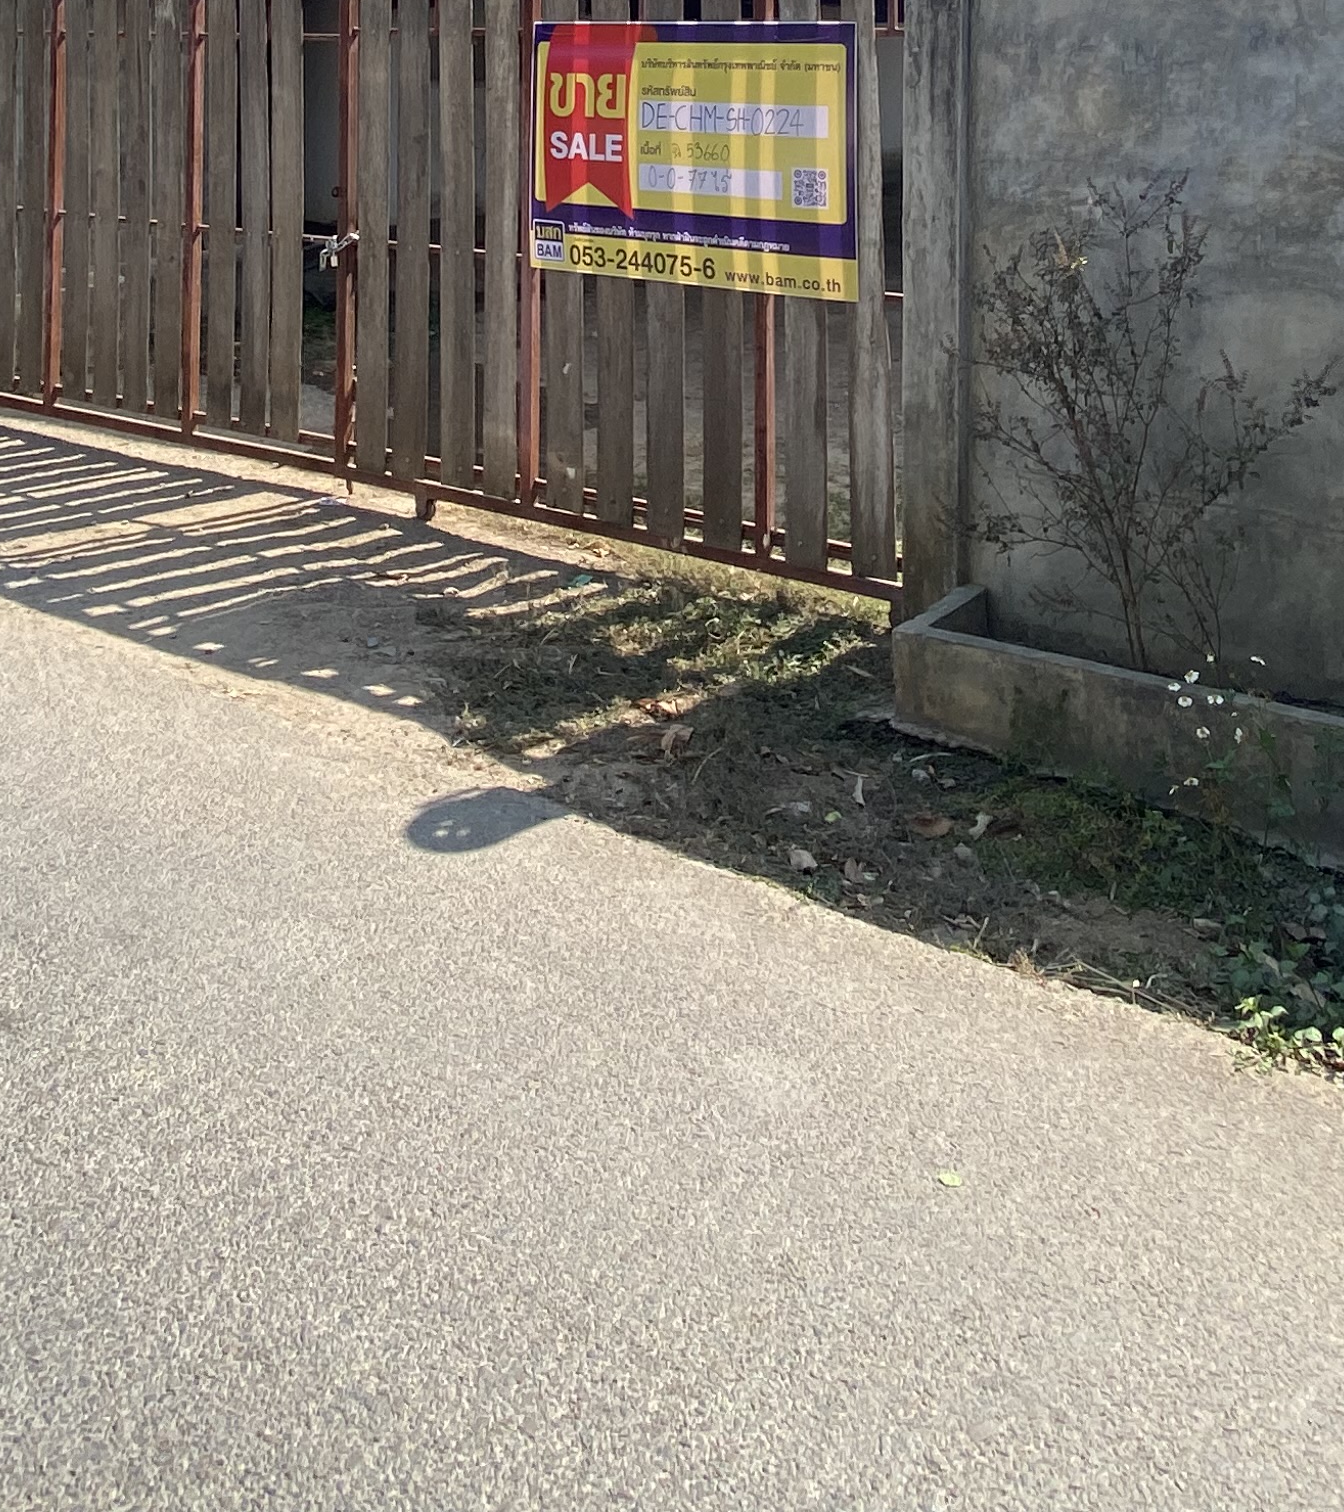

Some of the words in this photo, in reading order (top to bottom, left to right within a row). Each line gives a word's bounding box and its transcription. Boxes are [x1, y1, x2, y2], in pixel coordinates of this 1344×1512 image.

[780, 58, 801, 71] จำกัด
[549, 72, 626, 119] ขาย
[641, 84, 697, 97] รหัสทรัพย์สิน
[550, 130, 623, 162] SALE
[640, 140, 661, 156] เนื้อที่
[537, 243, 562, 258] BAM
[569, 245, 716, 280] 053-244075-6
[725, 271, 841, 294] www.bam.co.th
